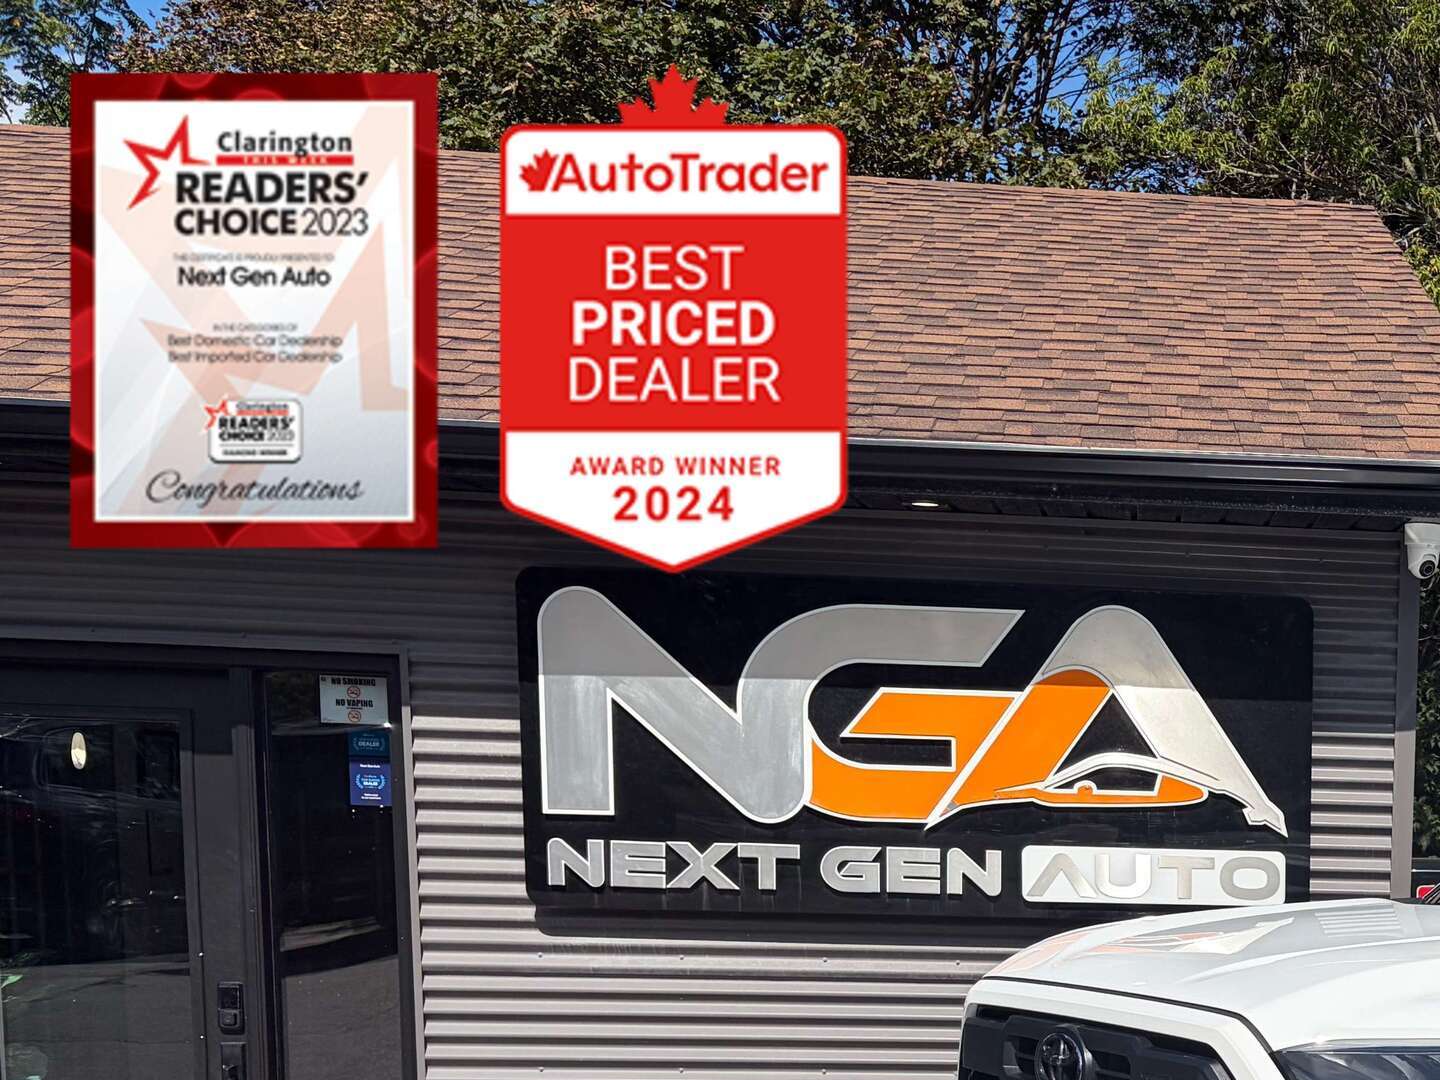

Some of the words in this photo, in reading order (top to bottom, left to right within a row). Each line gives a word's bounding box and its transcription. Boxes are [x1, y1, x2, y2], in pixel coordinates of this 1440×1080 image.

[335, 698, 345, 706] NO
[346, 698, 373, 707] VAPING
[537, 586, 1287, 837] NGA
[547, 837, 804, 891] NEXT
[819, 845, 1003, 898] GEN
[1027, 852, 1281, 900] AUTO
